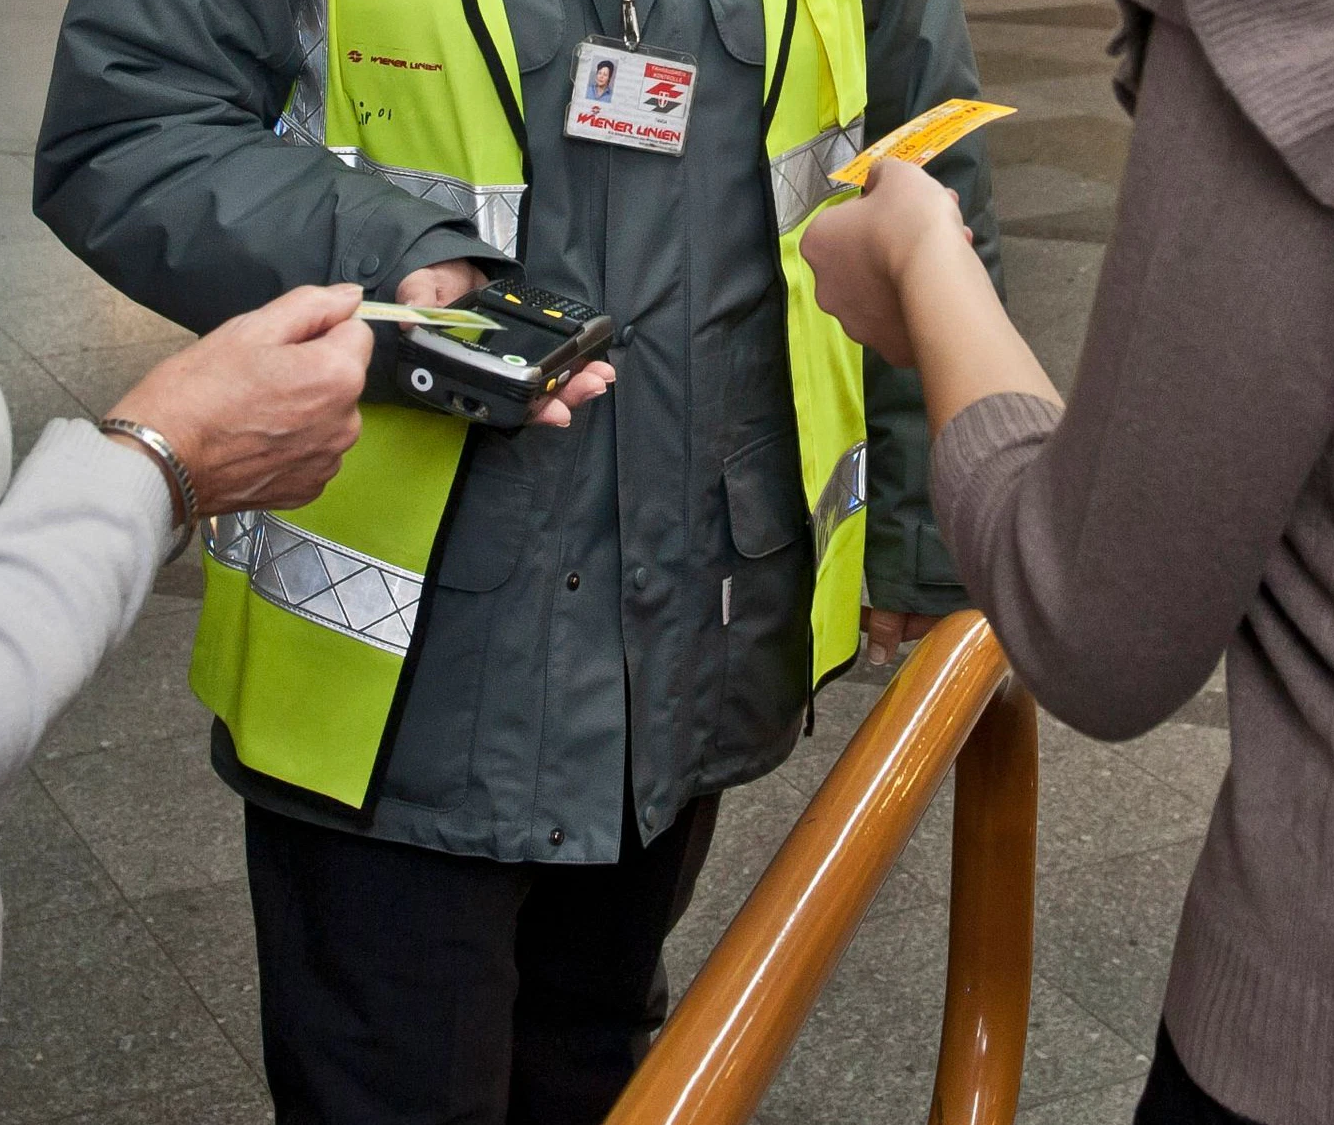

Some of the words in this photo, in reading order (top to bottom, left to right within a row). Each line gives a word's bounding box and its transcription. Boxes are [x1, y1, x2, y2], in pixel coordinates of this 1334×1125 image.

[370, 56, 407, 69] WIENER
[409, 62, 443, 72] LINIEN
[576, 112, 634, 134] WIENER
[635, 128, 682, 143] LINIEN
